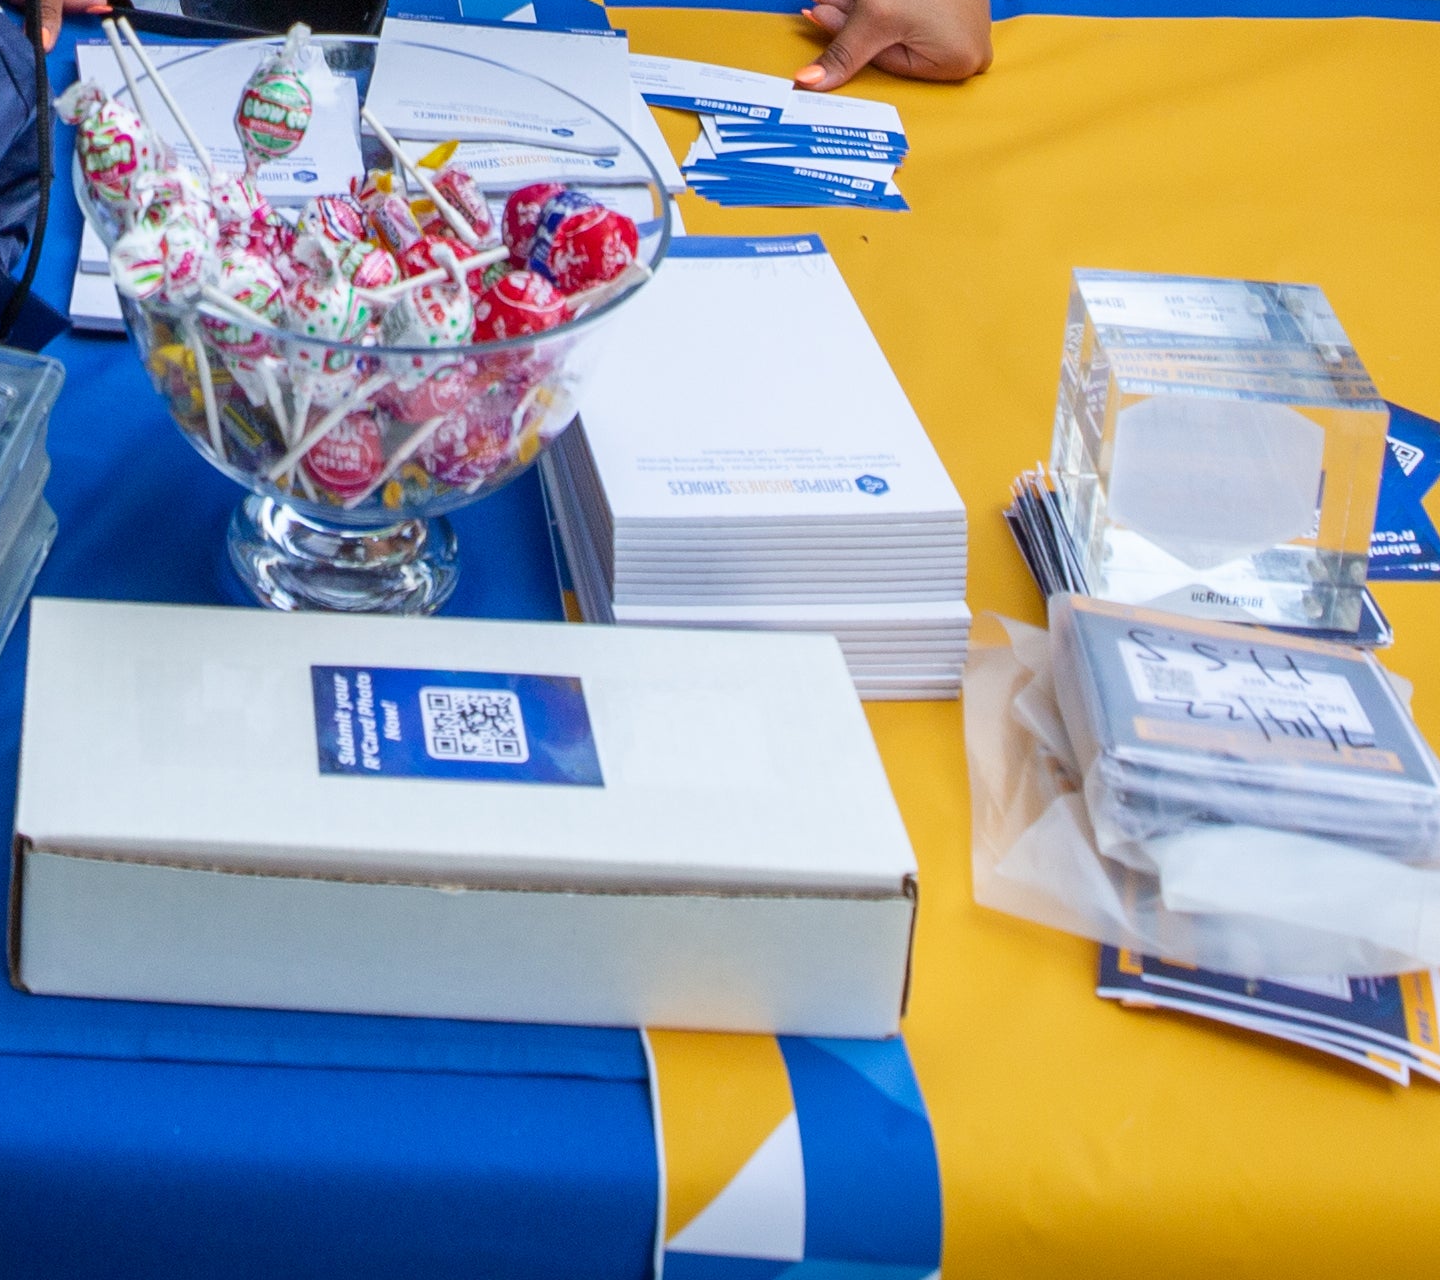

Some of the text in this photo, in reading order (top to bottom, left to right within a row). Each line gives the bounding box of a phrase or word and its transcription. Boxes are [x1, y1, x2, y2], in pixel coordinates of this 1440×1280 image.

[694, 97, 749, 114] RIVERSIDE
[286, 111, 308, 129] PO
[811, 125, 867, 139] RIVERSIDE
[793, 168, 851, 186] RIVERSIDE
[1368, 542, 1422, 558] Submi
[333, 672, 356, 766] Submit your
[356, 671, 381, 770] R'Card Photo
[381, 699, 402, 742] Now!
